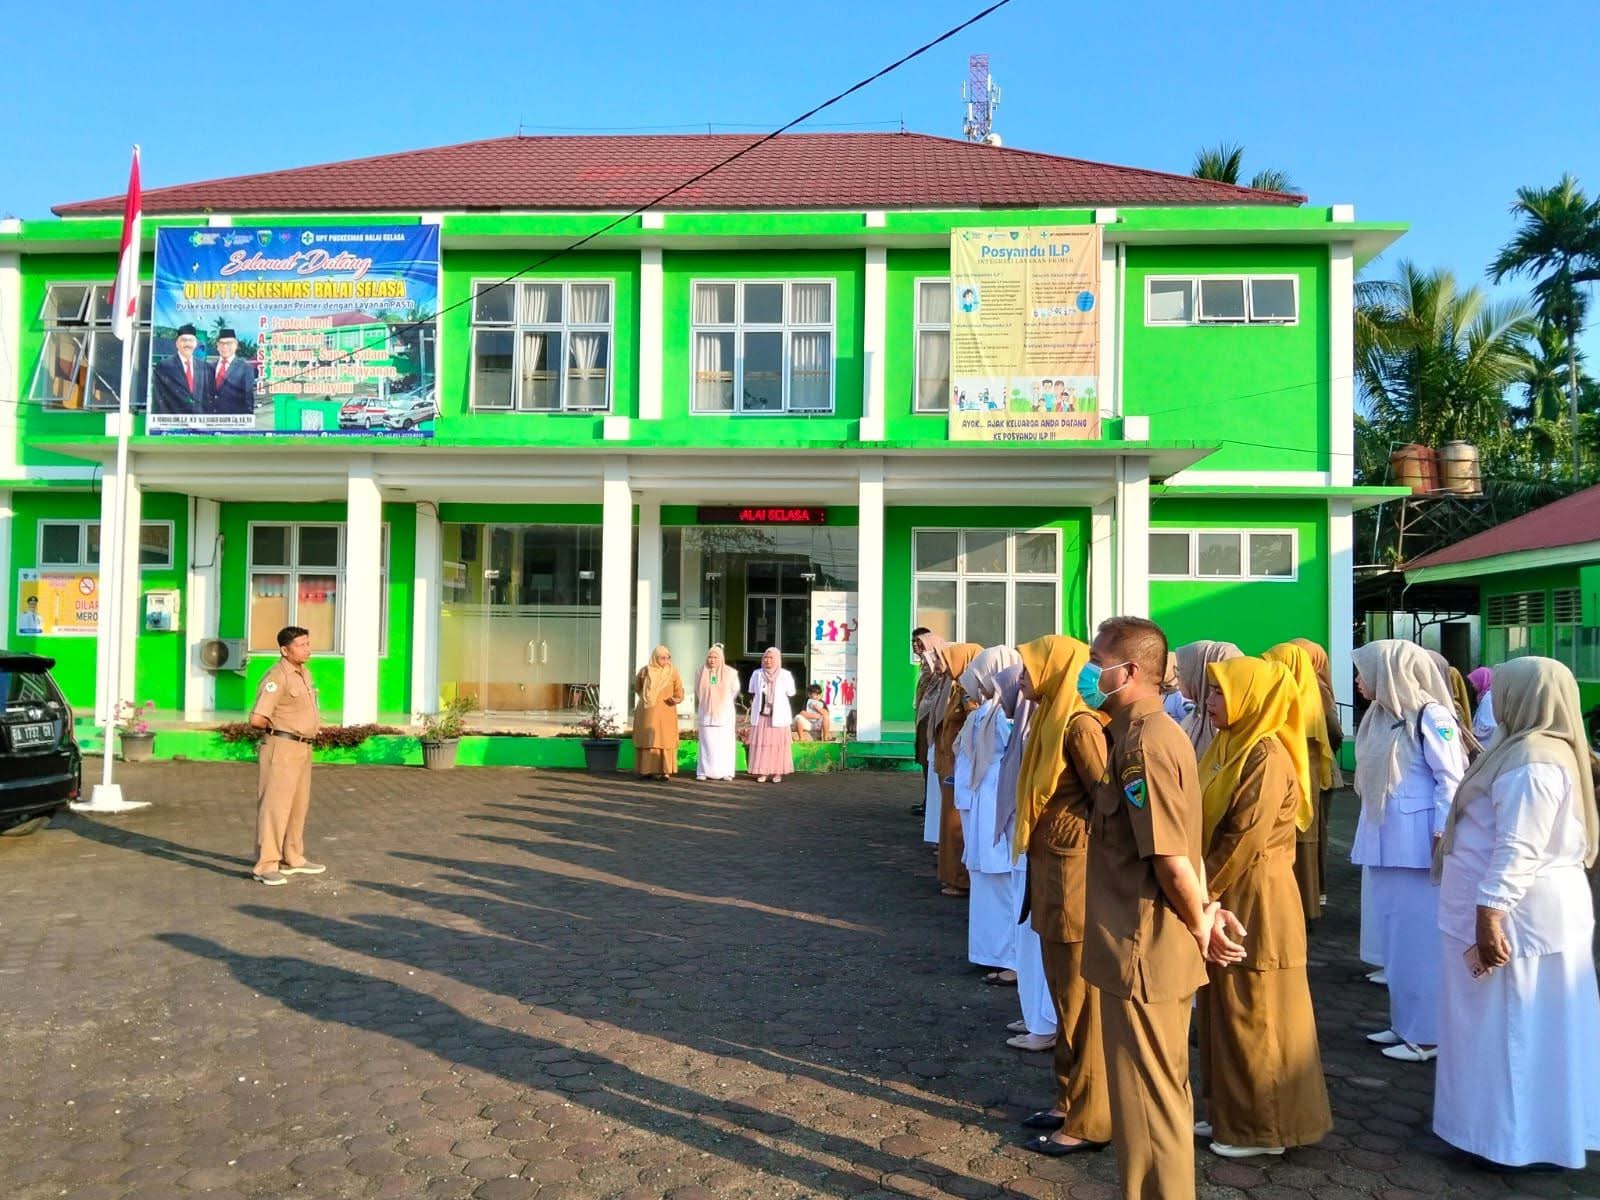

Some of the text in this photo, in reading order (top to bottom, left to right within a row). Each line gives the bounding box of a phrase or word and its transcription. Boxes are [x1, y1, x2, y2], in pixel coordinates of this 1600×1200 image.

[981, 244, 1070, 260] Posyandu ILP
[220, 249, 372, 280] Selamat Datang
[185, 280, 406, 300] DI UPT PUSKESMAS BALAI SELASA
[176, 300, 414, 311] Puskesmas Integrasi Layanan Primer dengan Layanan PASTI
[987, 420, 1005, 428] AJAK
[1006, 420, 1039, 428] KELUARGA
[1040, 419, 1060, 427] ANDA
[1061, 419, 1087, 427] DATANG
[993, 432, 1002, 440] KE
[1003, 432, 1037, 440] POSYANDU
[1039, 432, 1049, 440] ILP
[767, 509, 810, 521] SELASA
